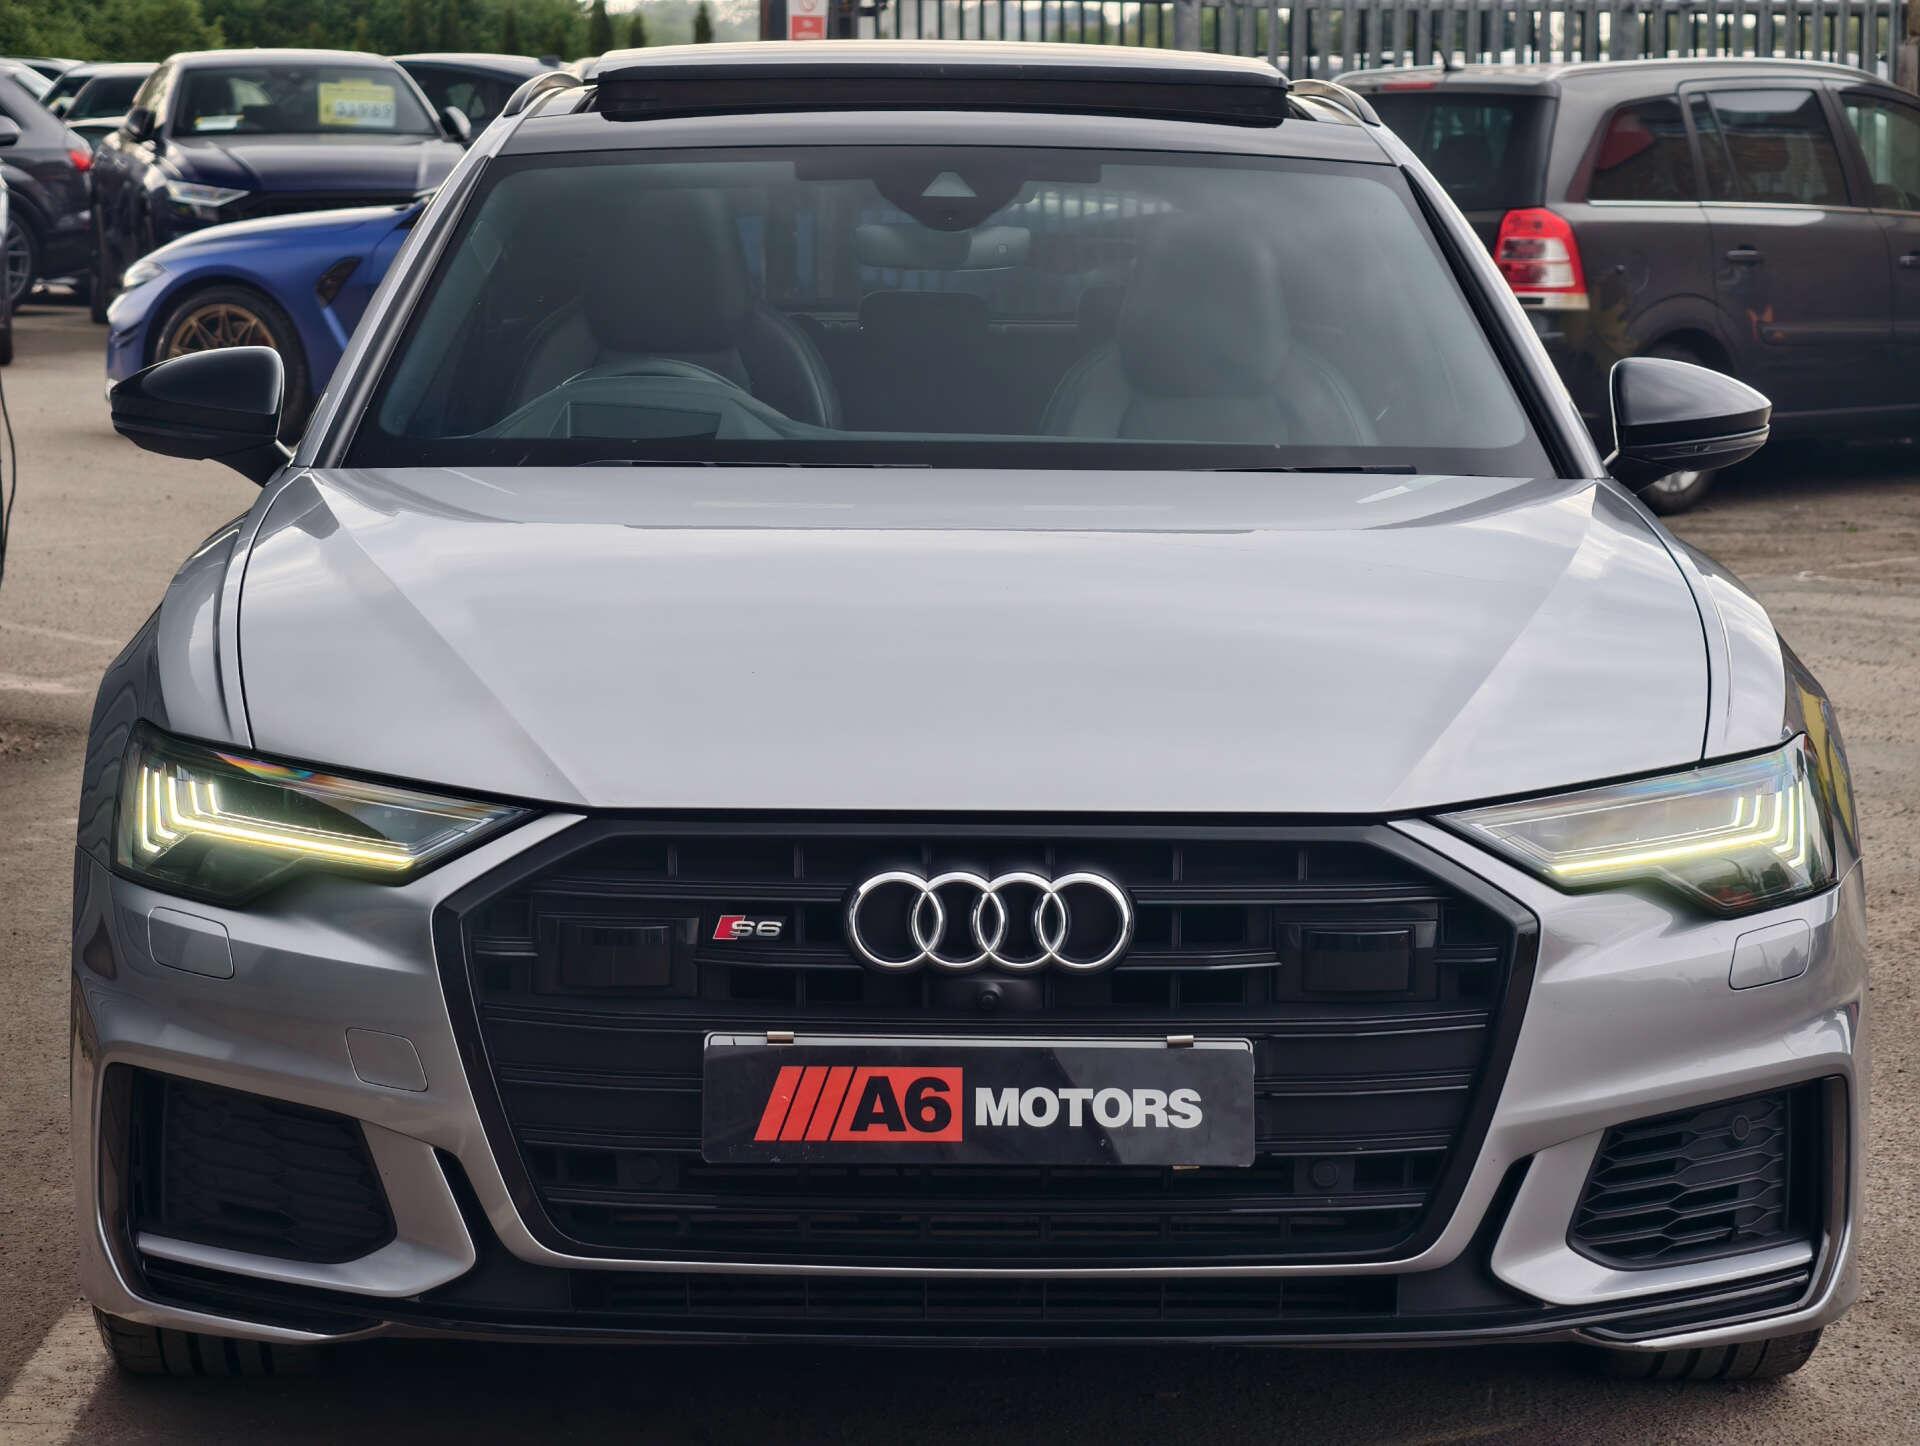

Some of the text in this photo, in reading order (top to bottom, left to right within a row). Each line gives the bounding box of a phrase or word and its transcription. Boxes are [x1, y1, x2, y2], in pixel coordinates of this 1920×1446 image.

[730, 920, 782, 937] S6
[849, 1075, 1202, 1132] A6 MOTORS
